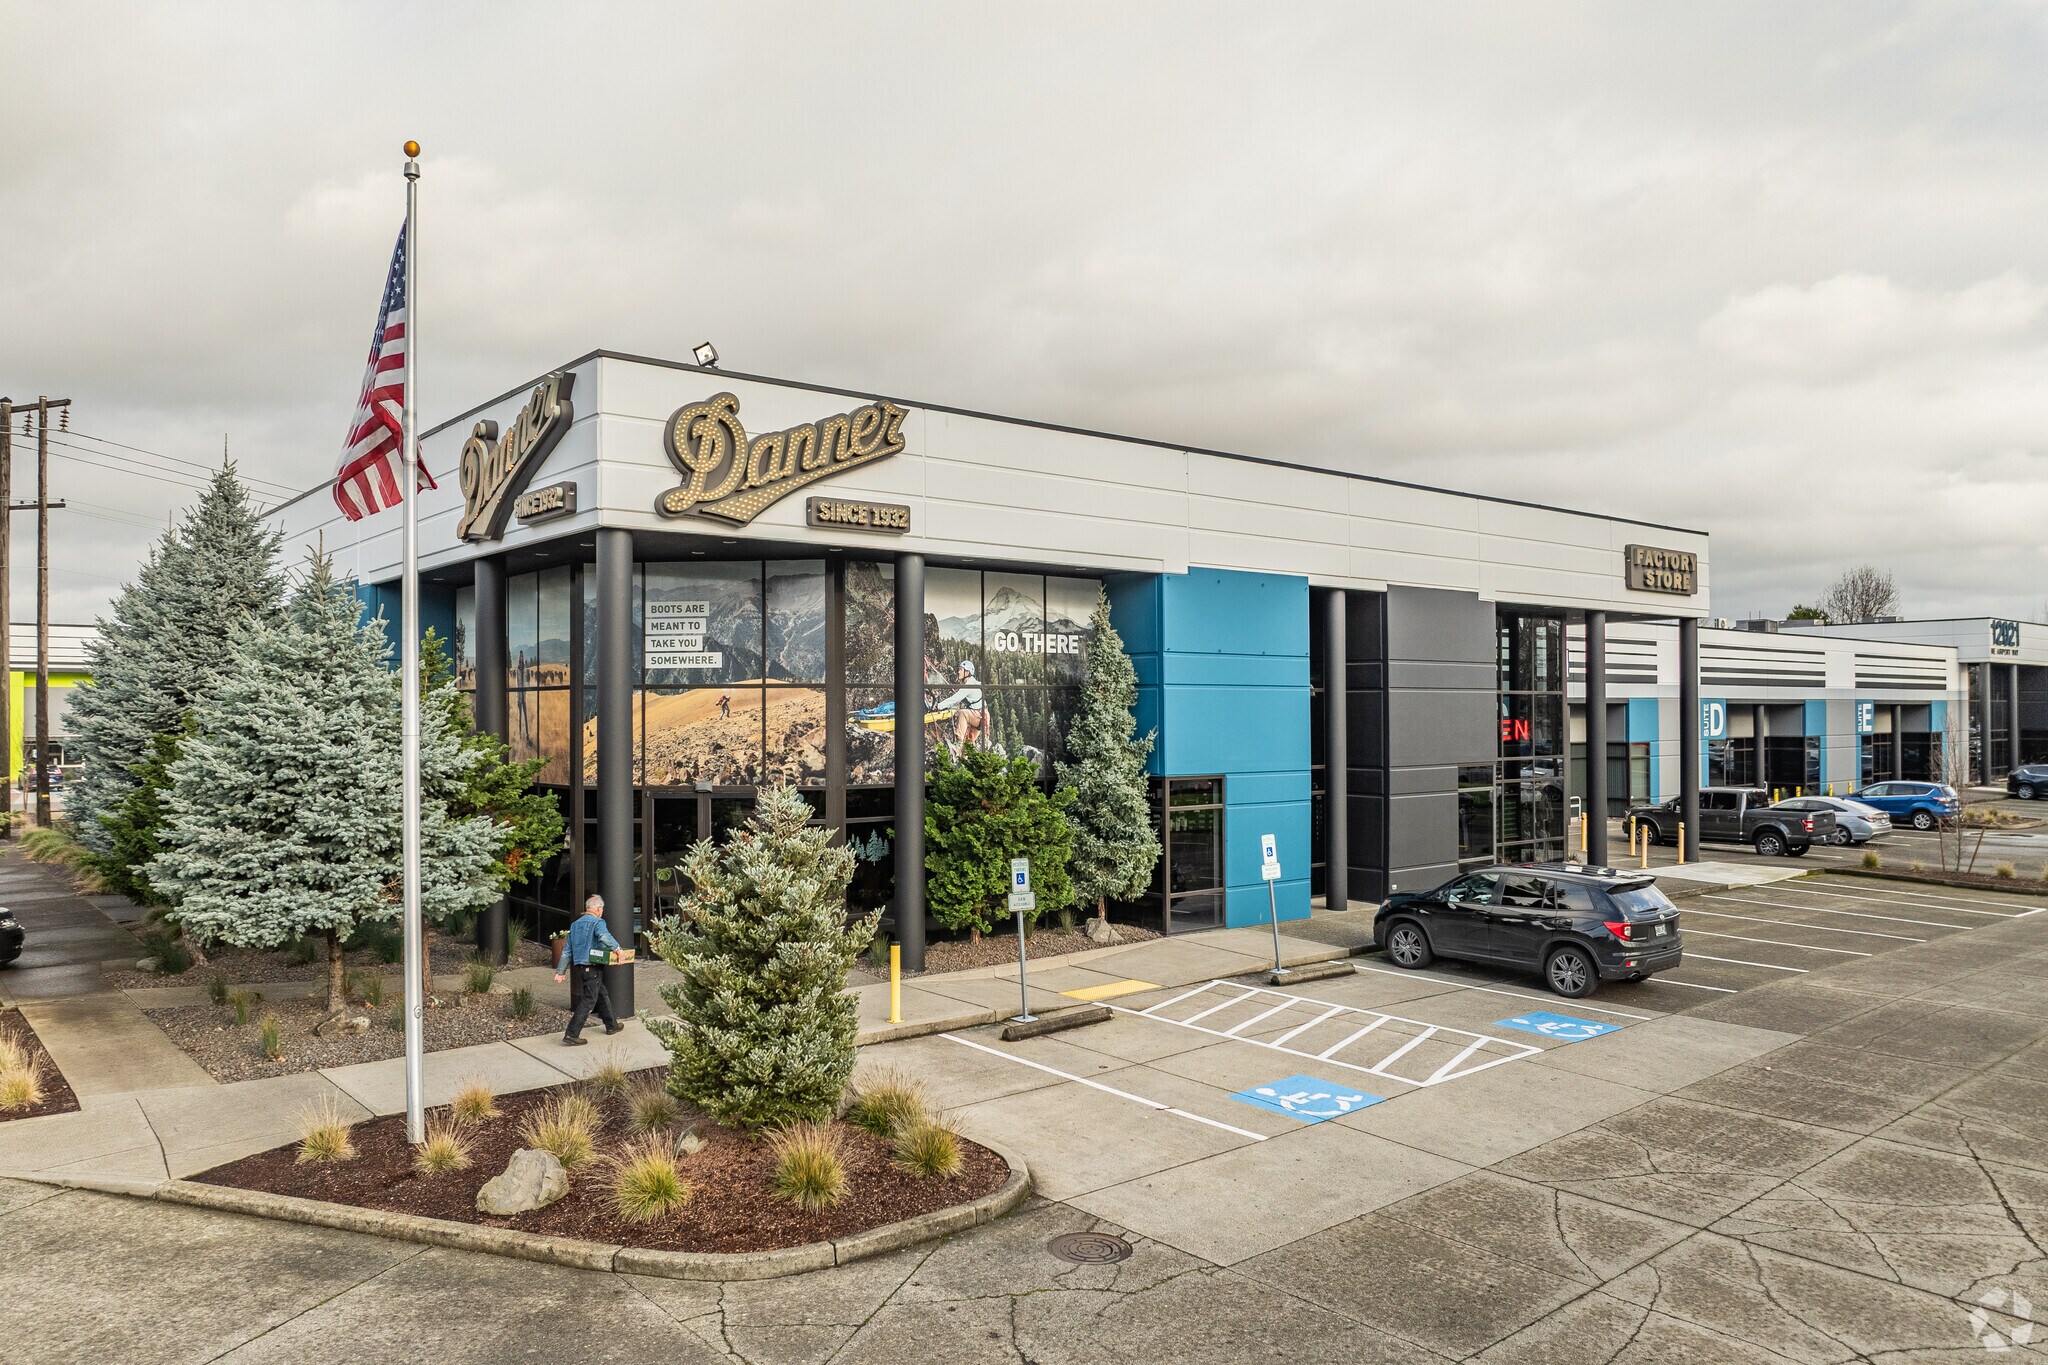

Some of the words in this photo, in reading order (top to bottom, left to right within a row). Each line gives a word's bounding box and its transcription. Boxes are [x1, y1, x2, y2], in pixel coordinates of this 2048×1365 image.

[663, 392, 910, 522] Danner
[539, 486, 563, 511] 1932
[818, 501, 868, 524] SINCE
[871, 506, 907, 528] 1932
[1635, 548, 1696, 572] FACTORY
[1644, 569, 1691, 590] STORE
[651, 604, 682, 614] BOOTS
[685, 604, 705, 613] ARE
[651, 621, 685, 631] MEANT
[688, 621, 700, 630] TO
[651, 639, 676, 648] TAKE
[678, 638, 697, 648] YOU
[994, 631, 1019, 652] GO
[1022, 633, 1079, 654] THERE
[651, 655, 717, 665] SOMEWHERE.
[1710, 703, 1724, 737] D
[1862, 703, 1873, 732] E
[1502, 719, 1529, 741] EN
